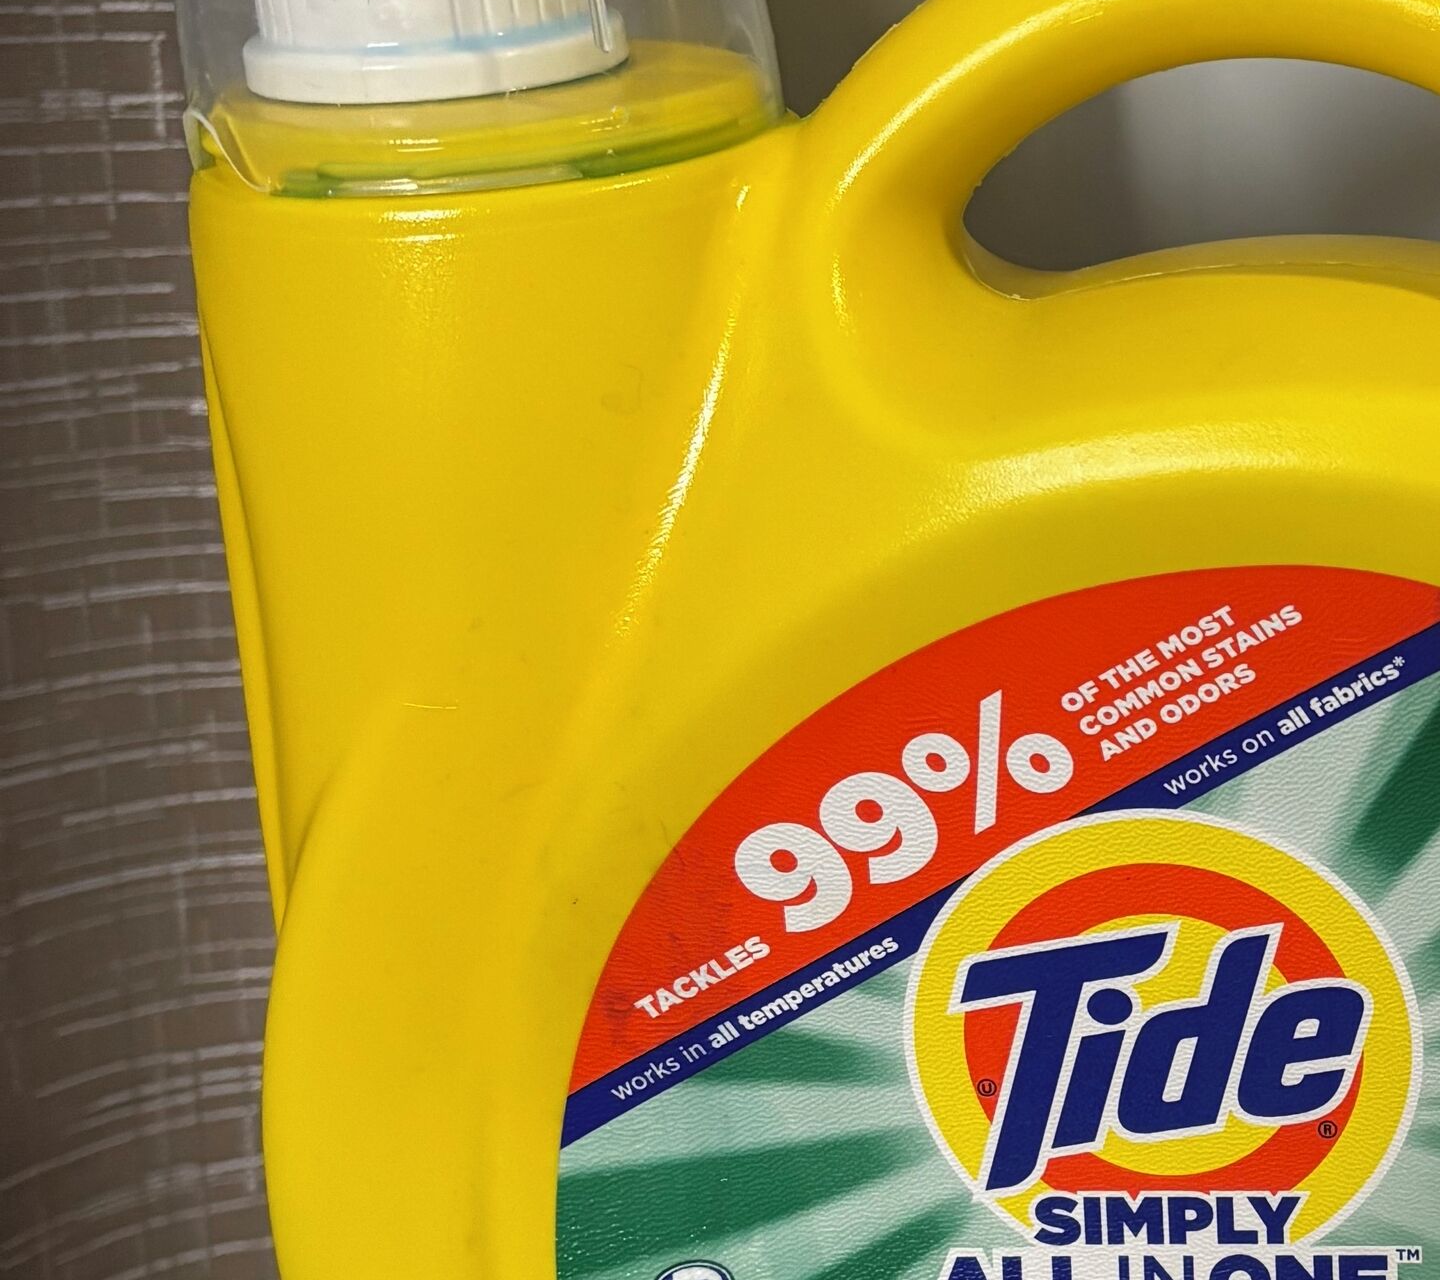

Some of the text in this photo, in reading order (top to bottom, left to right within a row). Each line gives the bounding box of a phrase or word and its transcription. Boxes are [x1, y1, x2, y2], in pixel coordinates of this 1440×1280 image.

[1060, 605, 1236, 712] OF THE MOST
[1079, 604, 1303, 736] COMMON STAINS
[1099, 663, 1257, 763] AND ODORS
[1163, 747, 1238, 796] works
[1241, 728, 1276, 754] on
[1276, 705, 1313, 737] all
[733, 689, 1075, 935] 99%
[610, 935, 900, 1102] works in all temperatures
[633, 935, 771, 1019] TACKLES
[952, 923, 1372, 1195] Tide
[1033, 1195, 1300, 1246] SIMPLY
